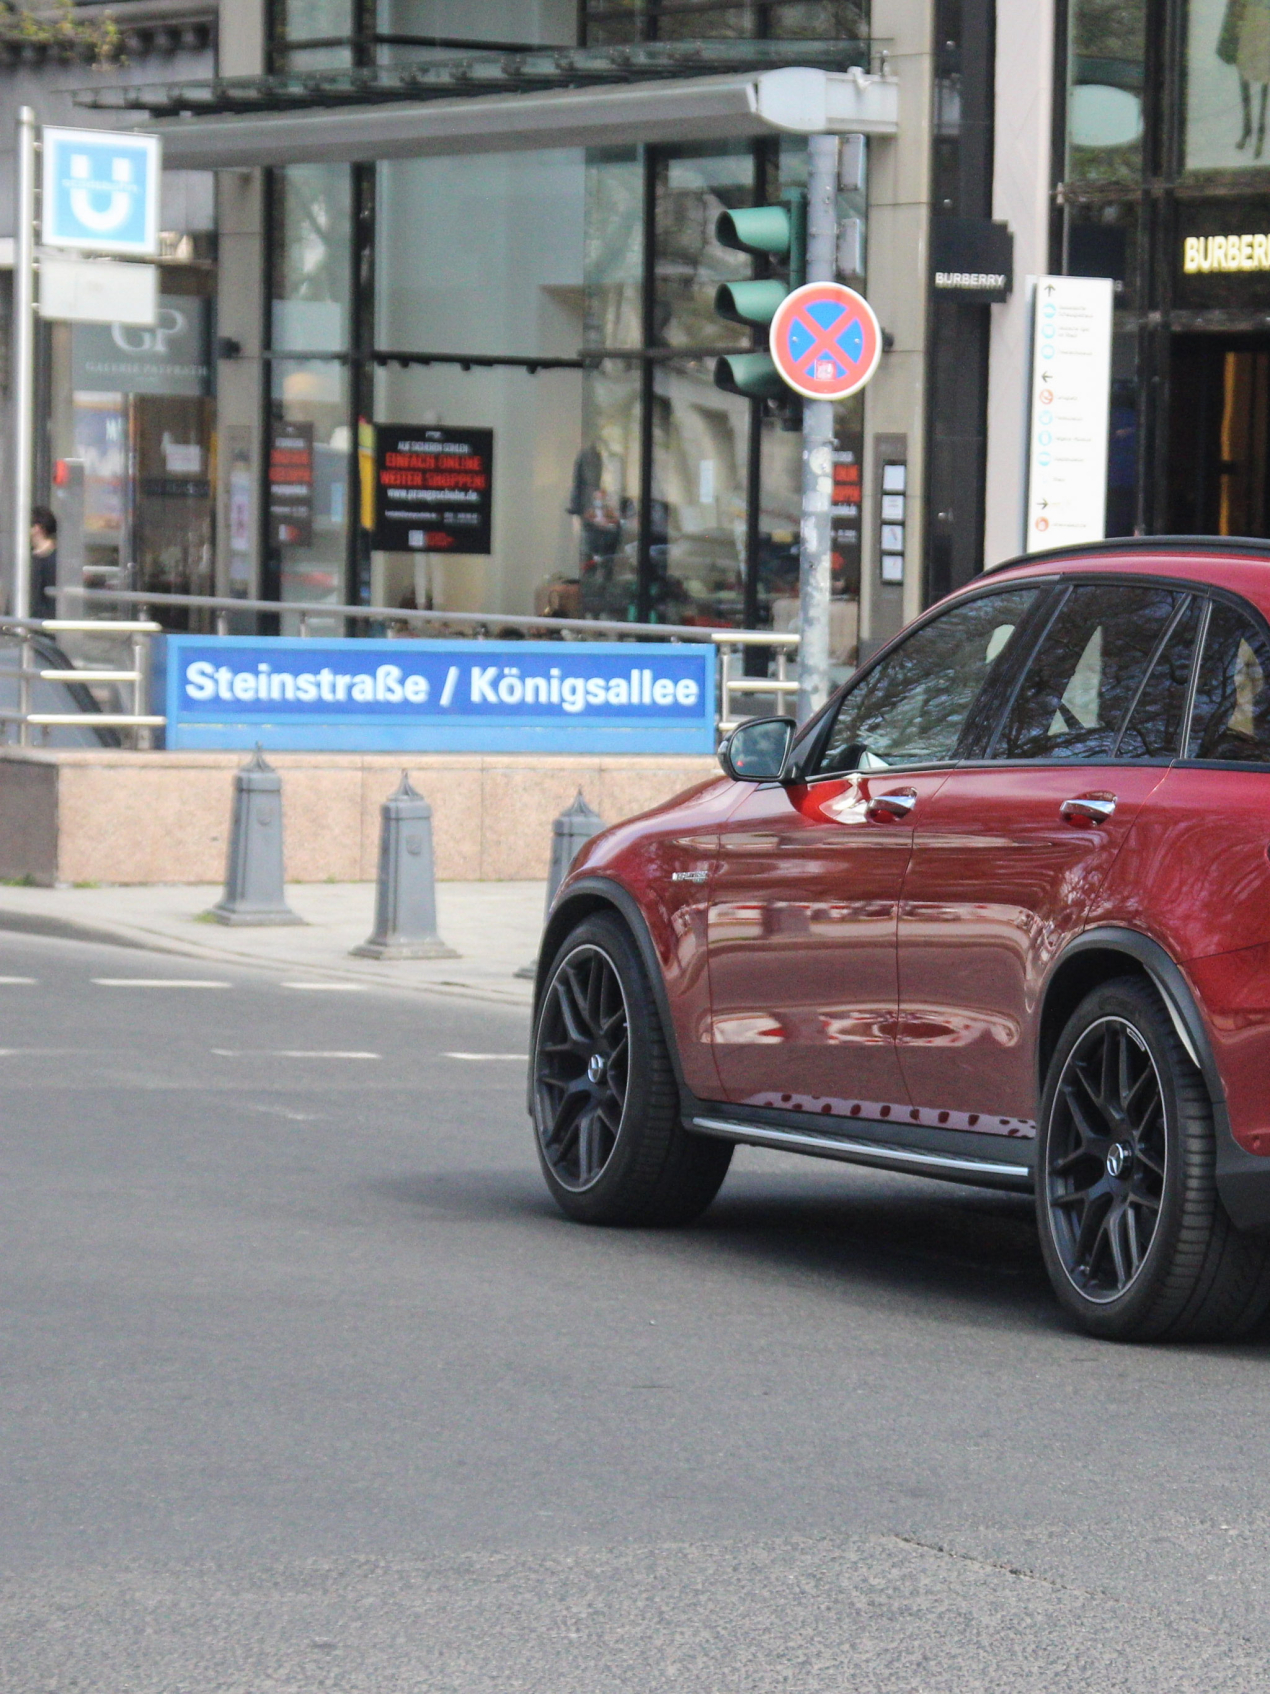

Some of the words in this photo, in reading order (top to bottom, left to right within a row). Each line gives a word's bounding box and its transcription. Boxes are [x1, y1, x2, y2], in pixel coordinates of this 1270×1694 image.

[935, 272, 1005, 288] BURBERRY
[185, 661, 428, 702] Steinstraße
[470, 666, 699, 712] Königsallee
